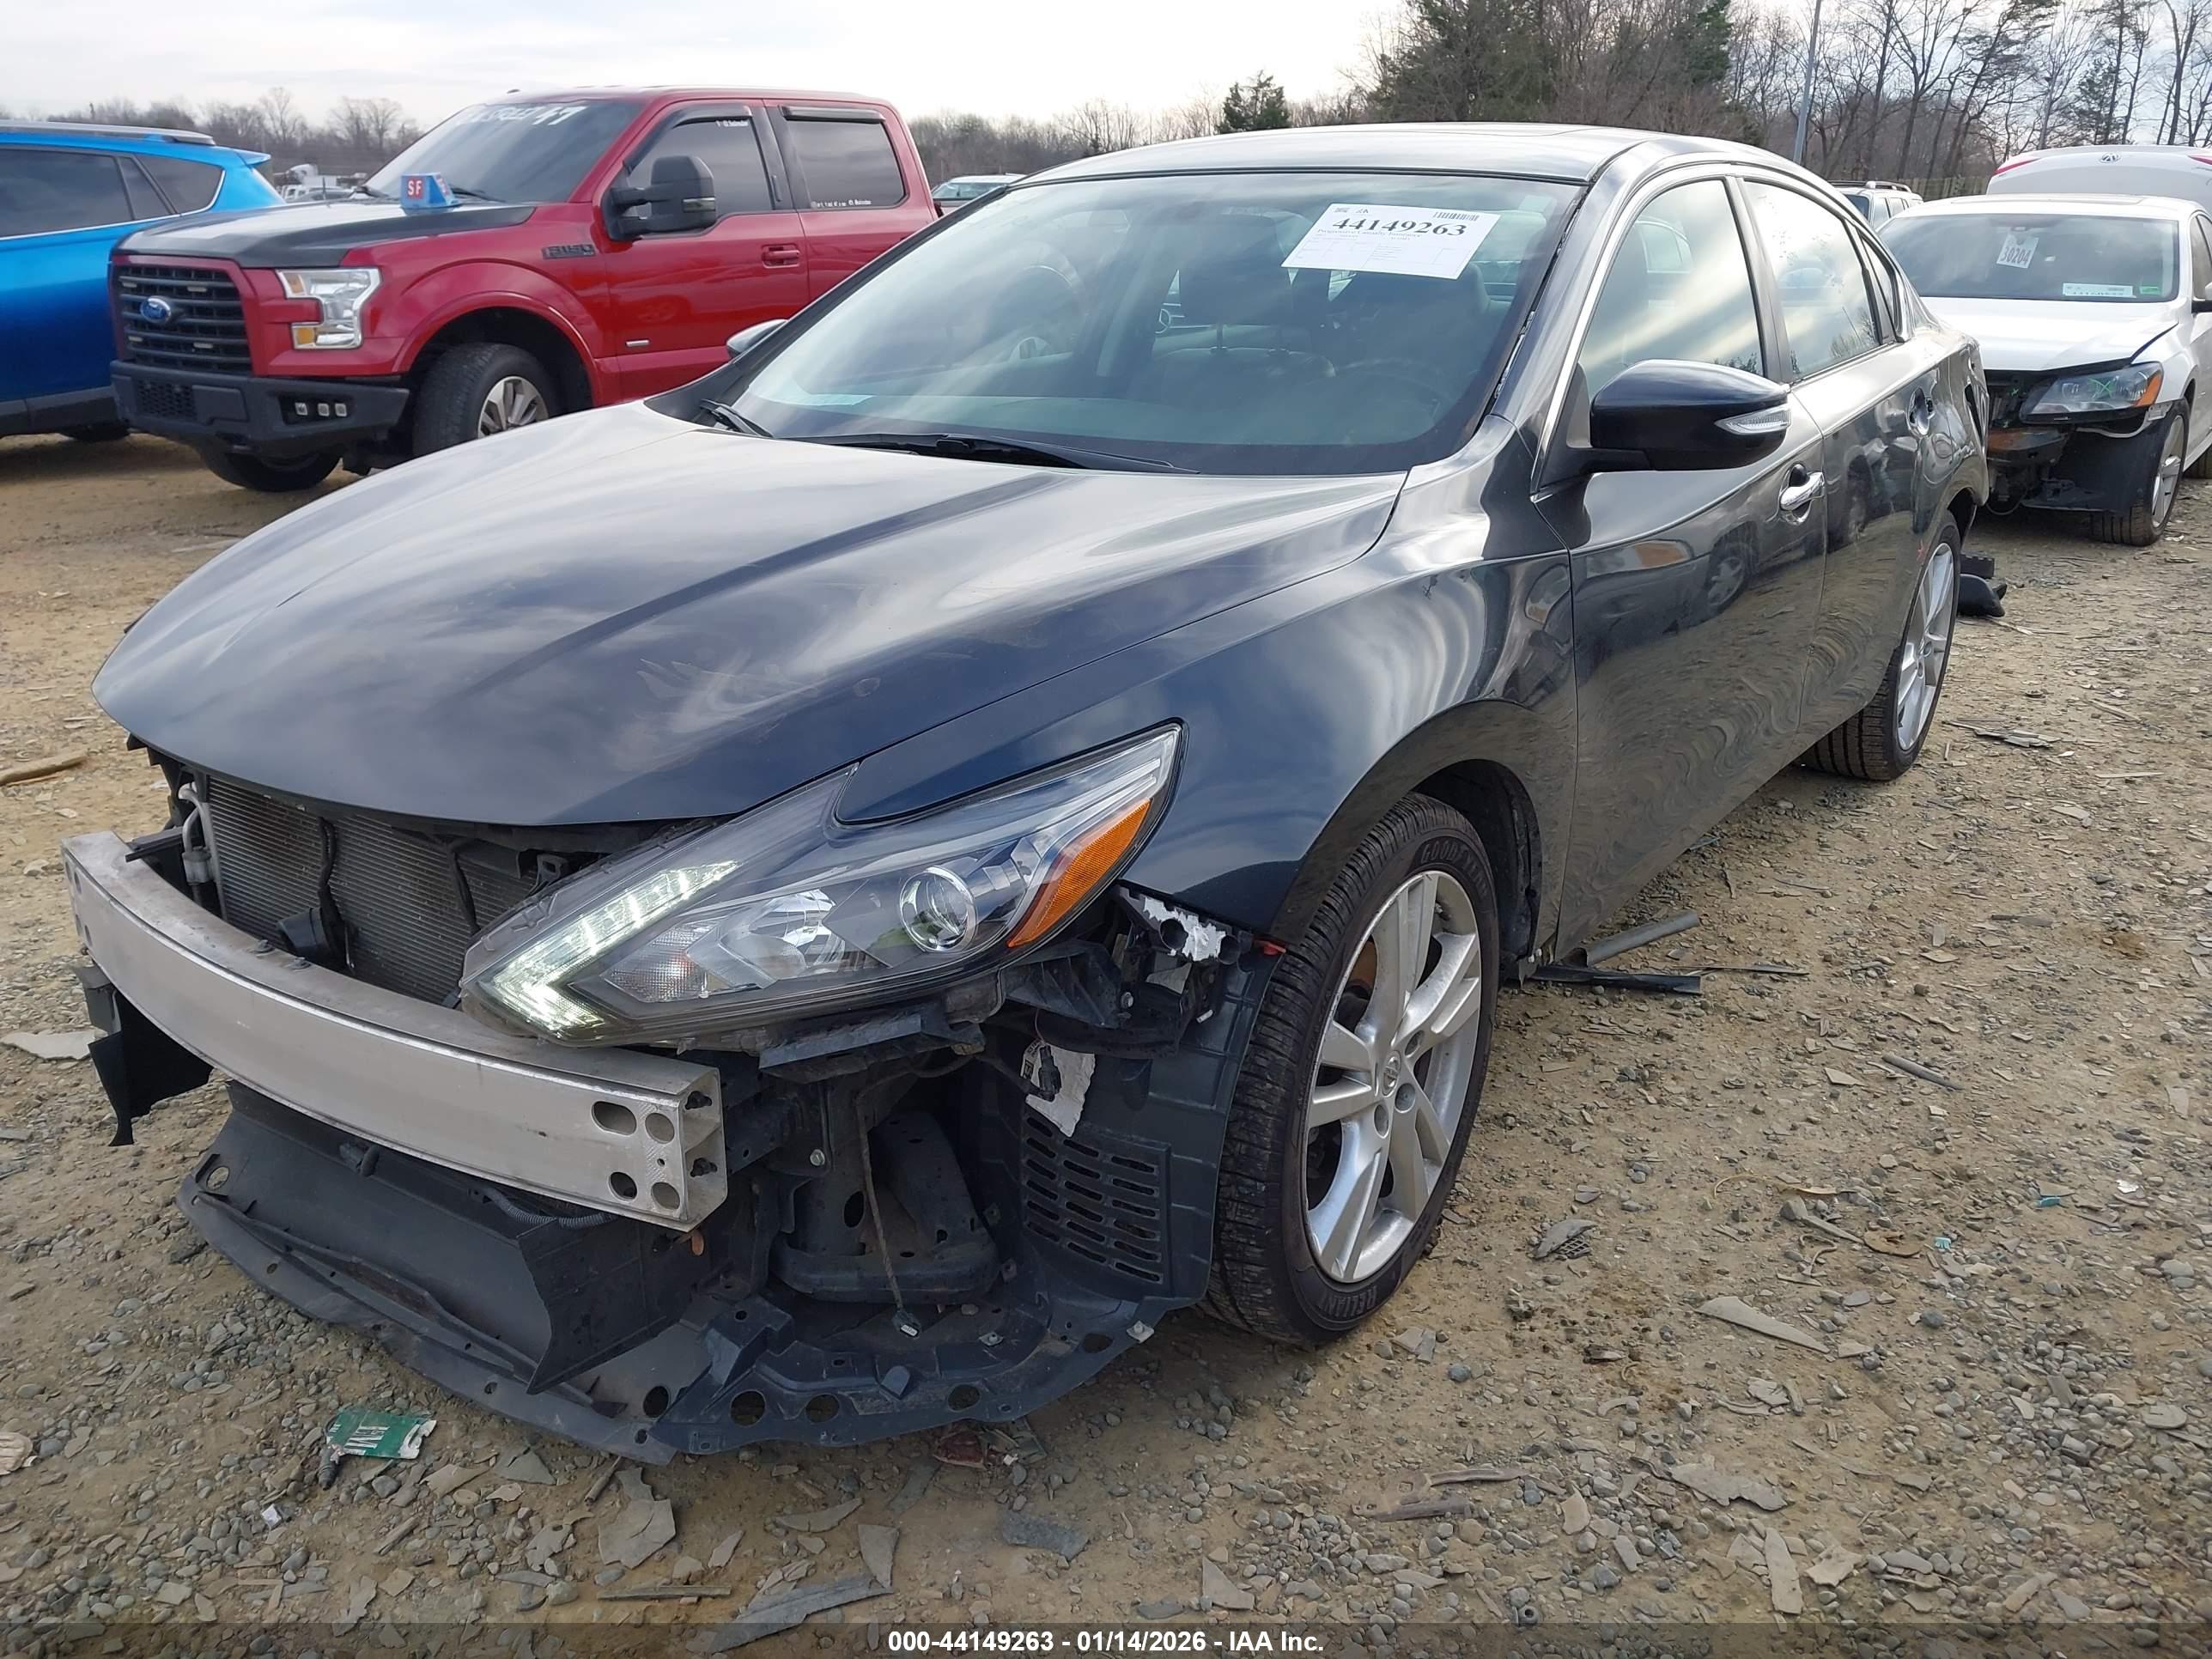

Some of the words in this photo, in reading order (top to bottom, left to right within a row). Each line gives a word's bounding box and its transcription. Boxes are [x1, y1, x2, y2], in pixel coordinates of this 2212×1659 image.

[407, 179, 423, 197] SF
[1333, 217, 1468, 237] 44149263
[1999, 246, 2032, 266] 30204
